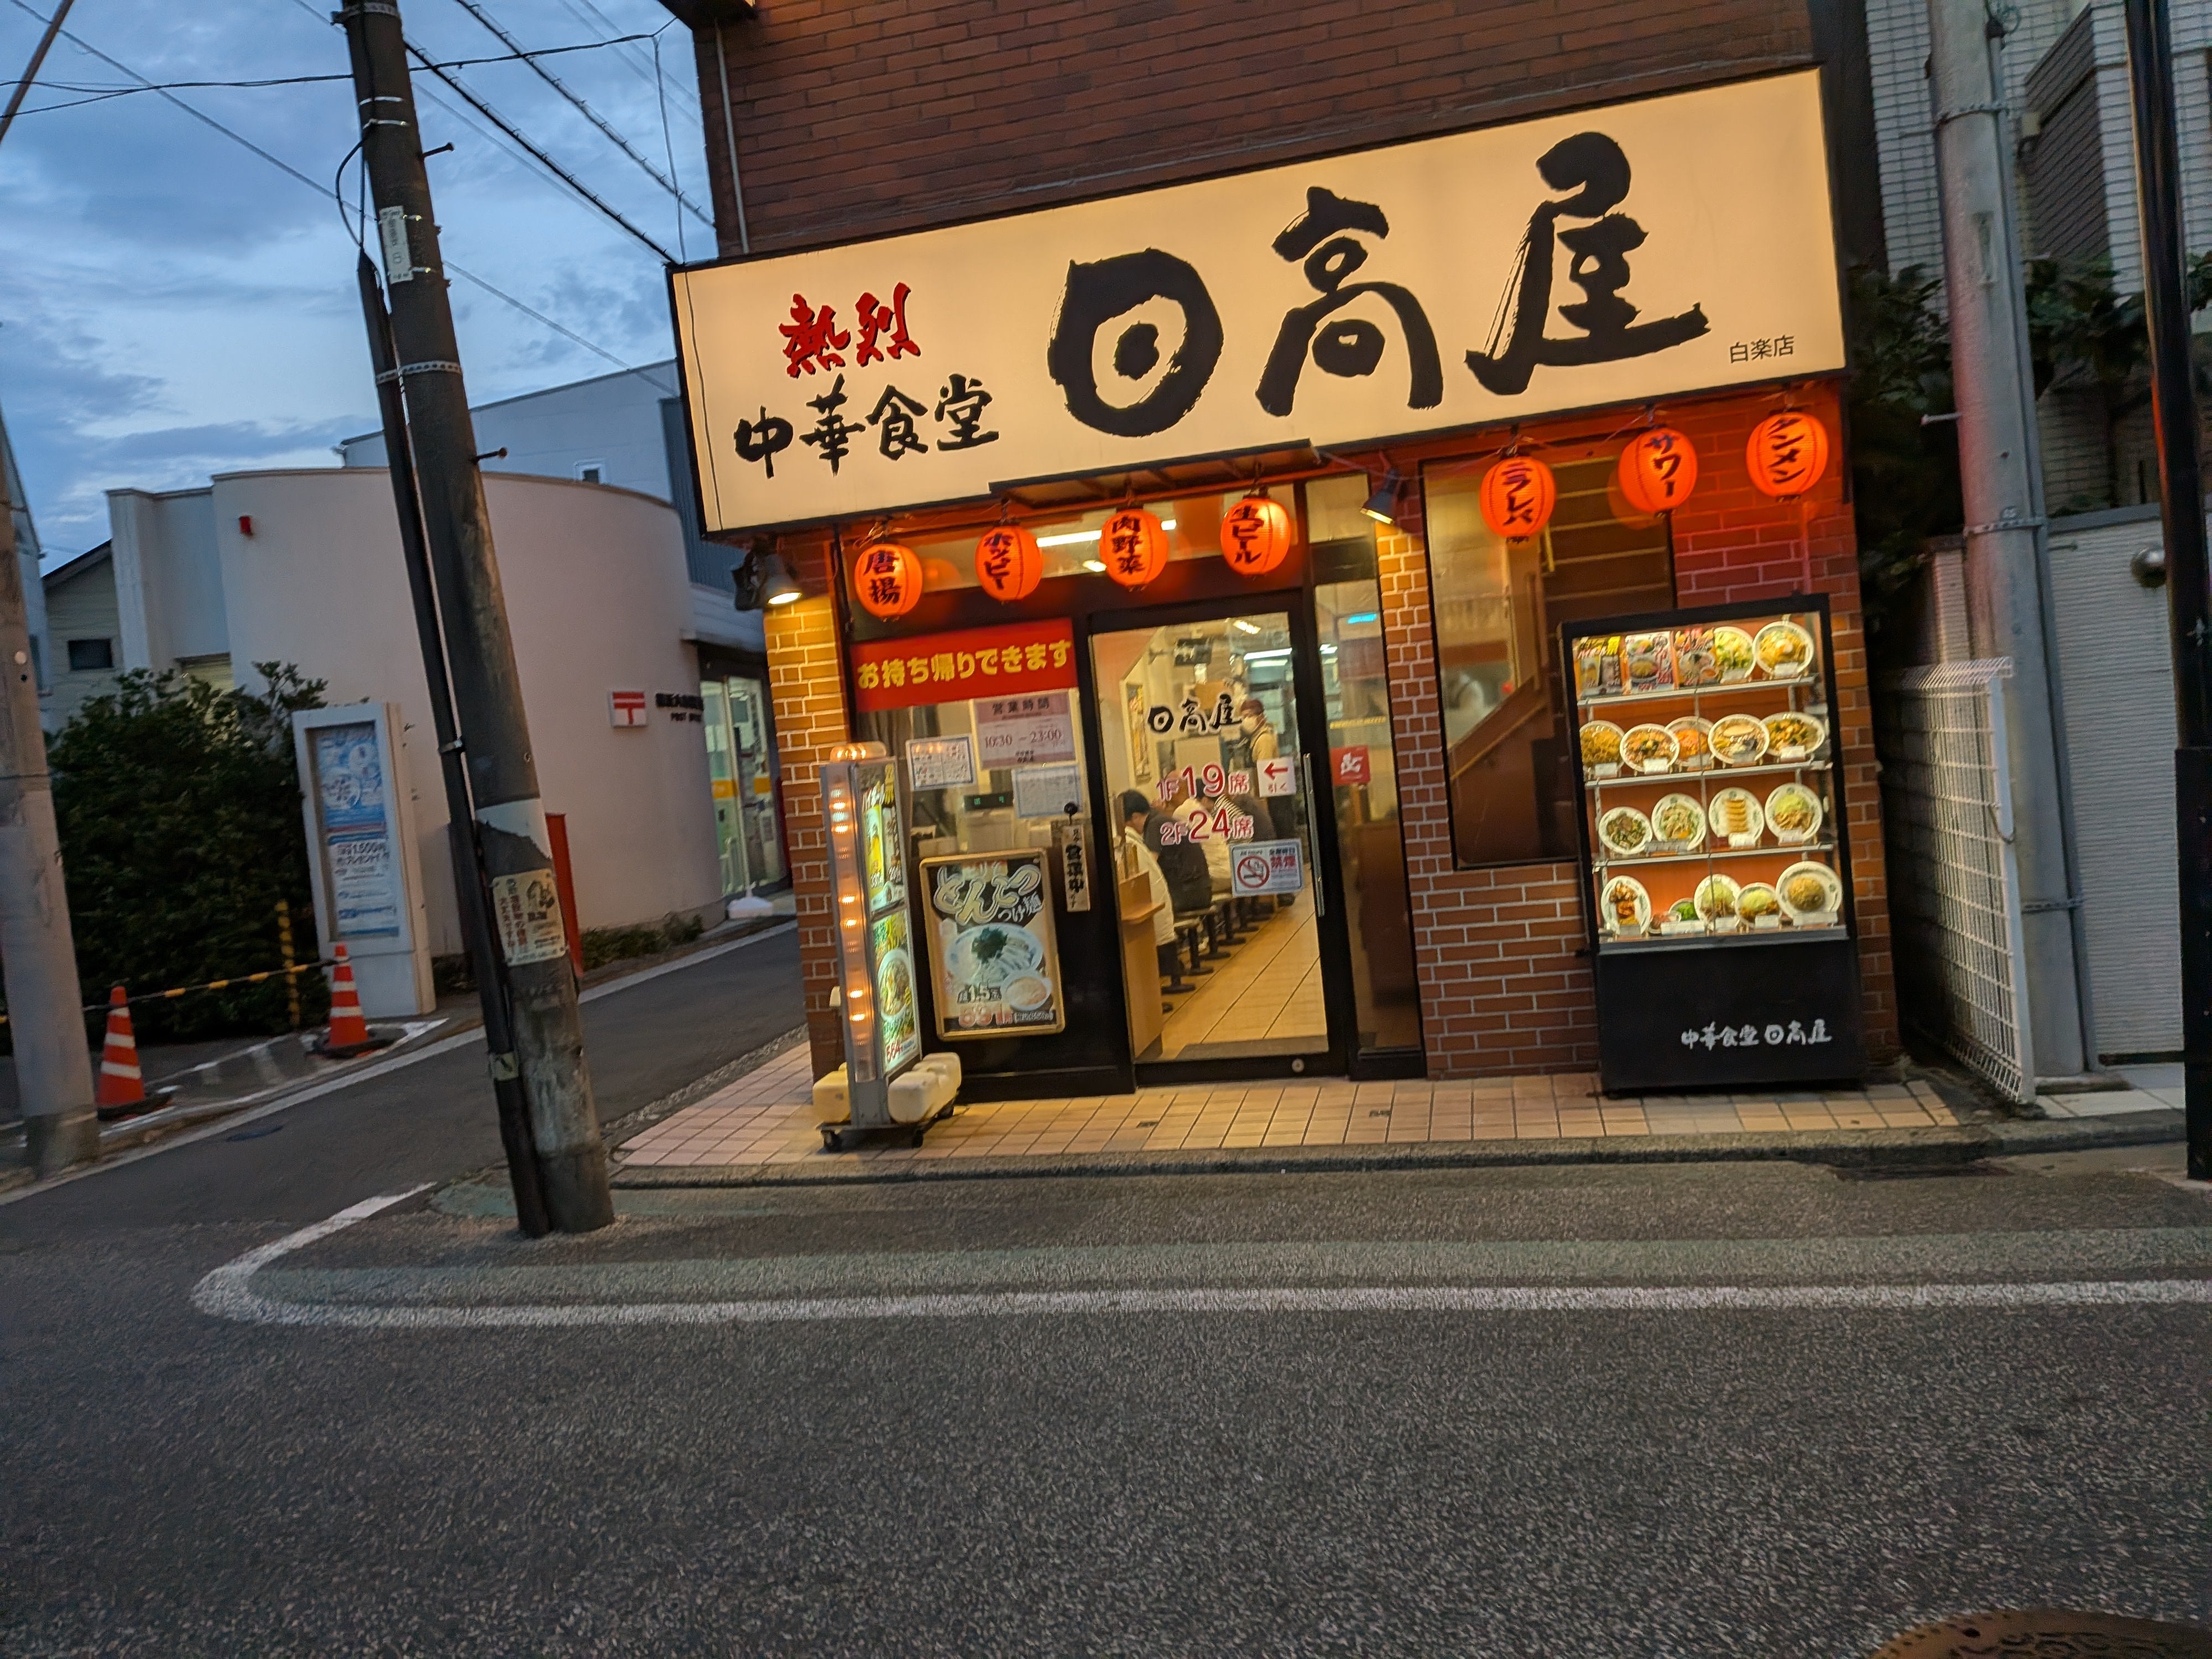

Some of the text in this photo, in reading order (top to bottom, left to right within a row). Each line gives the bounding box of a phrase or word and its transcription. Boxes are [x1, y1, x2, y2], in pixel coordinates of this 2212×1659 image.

[1047, 131, 1711, 437] 日高屋
[779, 282, 921, 378] 熱烈
[1729, 335, 1794, 363] 白楽店
[734, 373, 999, 479] 中華食堂
[1767, 418, 1805, 484] タンメン
[1645, 432, 1682, 497] サワー
[1501, 462, 1535, 526] ニラレバ
[983, 533, 1014, 591] ホッピー
[1112, 515, 1145, 575] 肉野菜
[1229, 505, 1265, 565] 生ビール
[863, 550, 901, 605] 唐揚
[857, 639, 1072, 690] お持ち帰りできます
[992, 697, 1050, 716] 営業時間
[1147, 693, 1243, 733] 日高屋
[984, 734, 1013, 748] 10:30
[1029, 728, 1062, 744] 23:00
[1267, 782, 1287, 792] 引く
[1681, 1018, 1833, 1051] 中華食堂 日高屋
